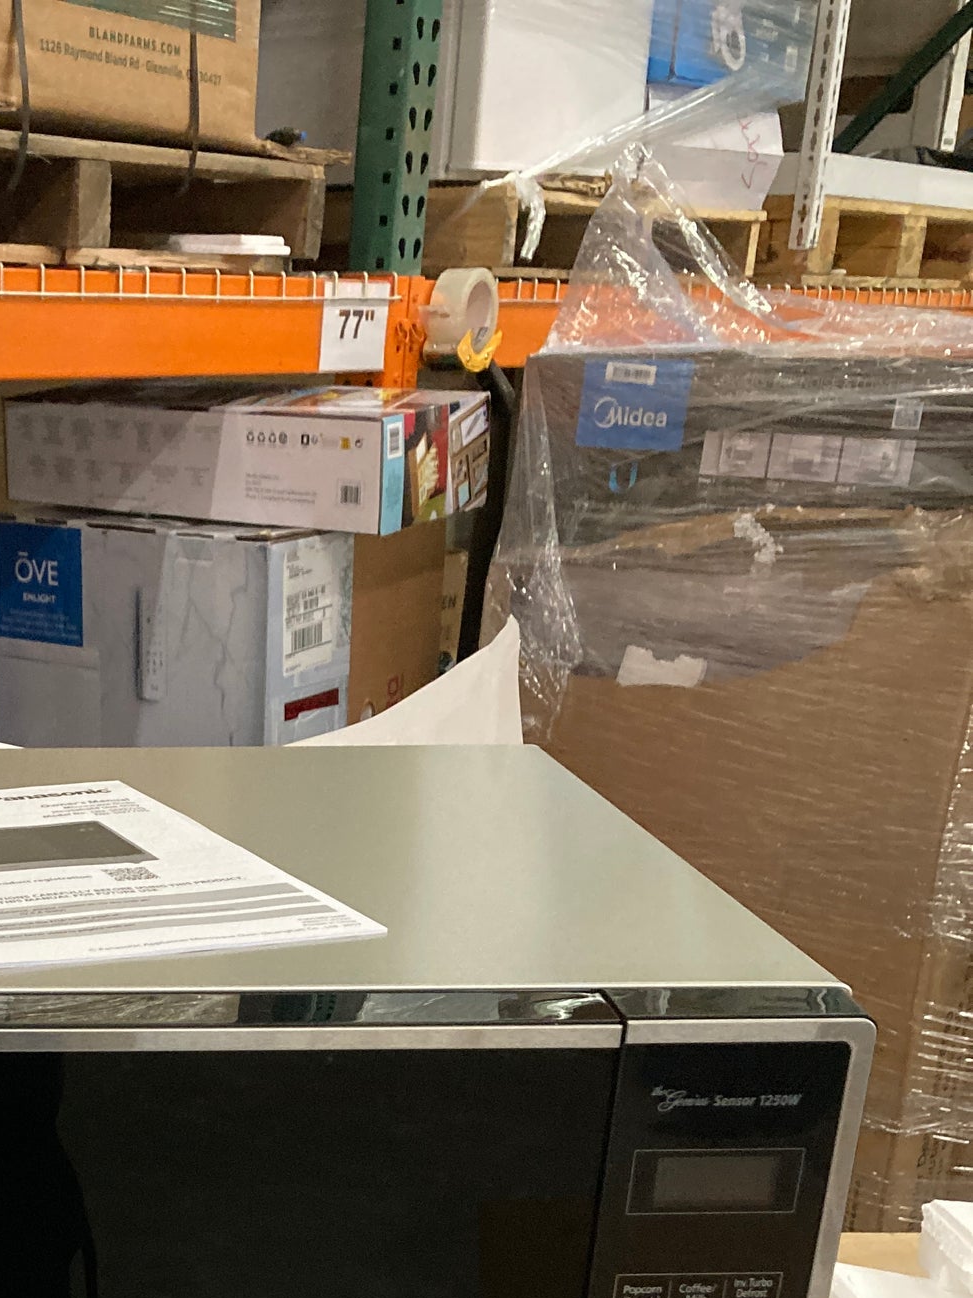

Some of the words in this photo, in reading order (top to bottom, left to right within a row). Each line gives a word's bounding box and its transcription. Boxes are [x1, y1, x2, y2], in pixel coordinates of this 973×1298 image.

[88, 26, 182, 56] BLANDFARMS.COM
[63, 43, 104, 64] Raymond
[104, 52, 128, 68] Bland
[129, 57, 141, 71] Rd
[339, 308, 375, 340] 77"
[594, 396, 668, 428] Midea
[658, 1090, 710, 1112] Genius
[713, 1095, 757, 1107] Sensor
[759, 1094, 802, 1107] 1250W
[622, 1284, 663, 1297] Popcorn
[735, 1288, 768, 1298] Defrost
[749, 1277, 773, 1288] Turbo
